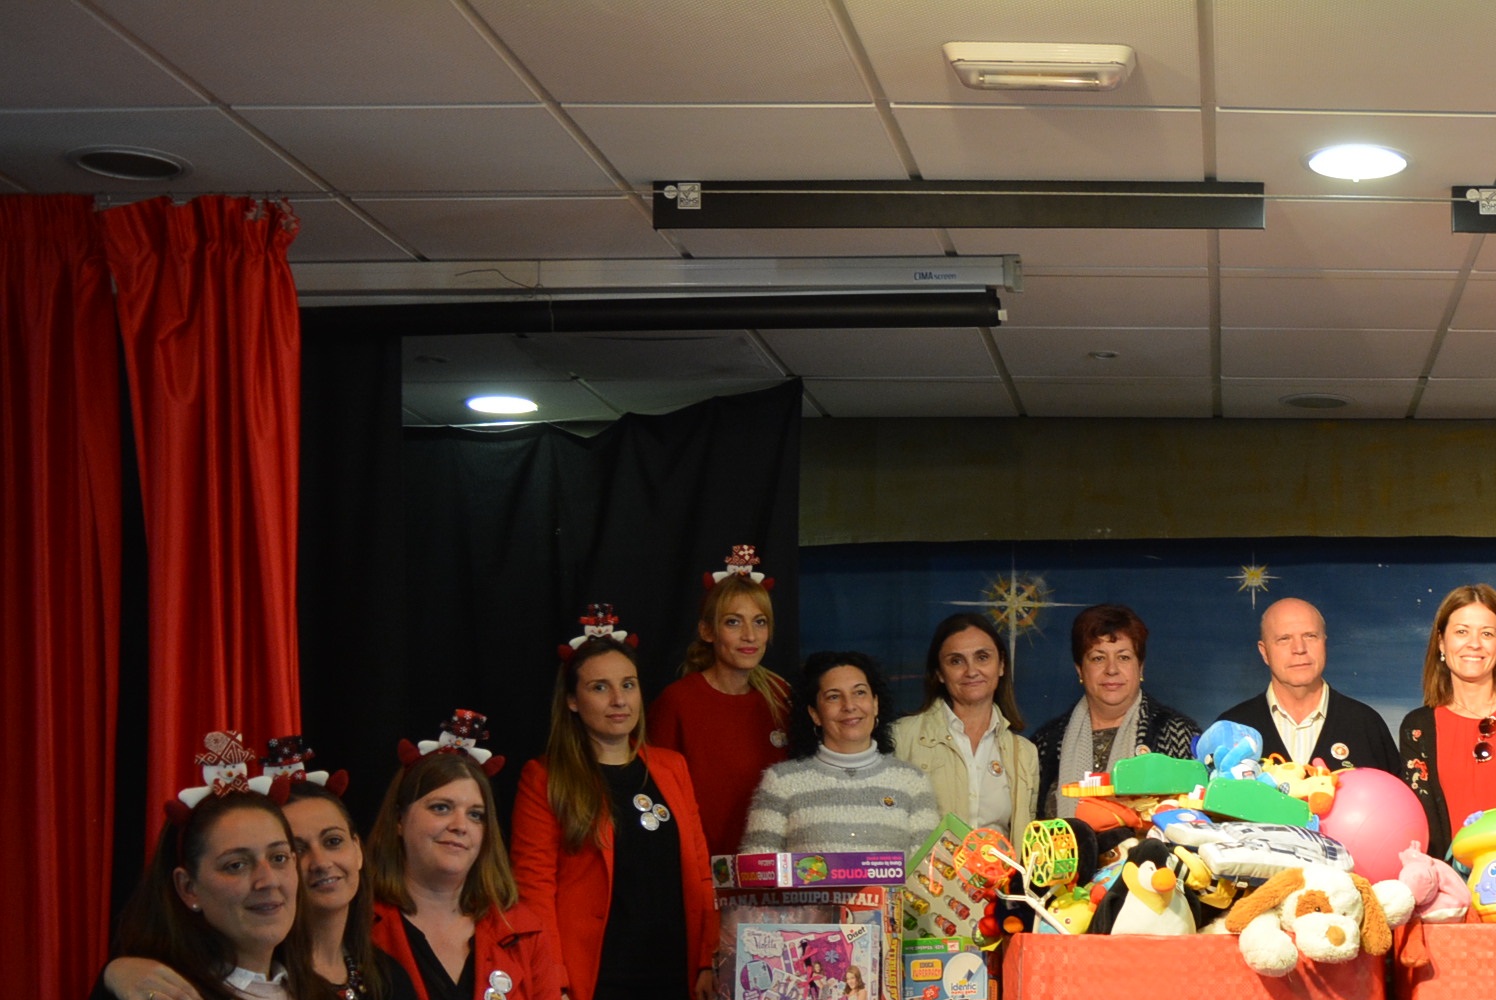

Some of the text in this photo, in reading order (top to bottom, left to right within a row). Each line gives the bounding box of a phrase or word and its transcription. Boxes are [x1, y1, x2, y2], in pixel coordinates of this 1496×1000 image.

[831, 867, 903, 880] comeranas
[783, 892, 830, 904] EQUIPO
[833, 892, 879, 907] RIVAL!
[847, 927, 865, 941] Diset
